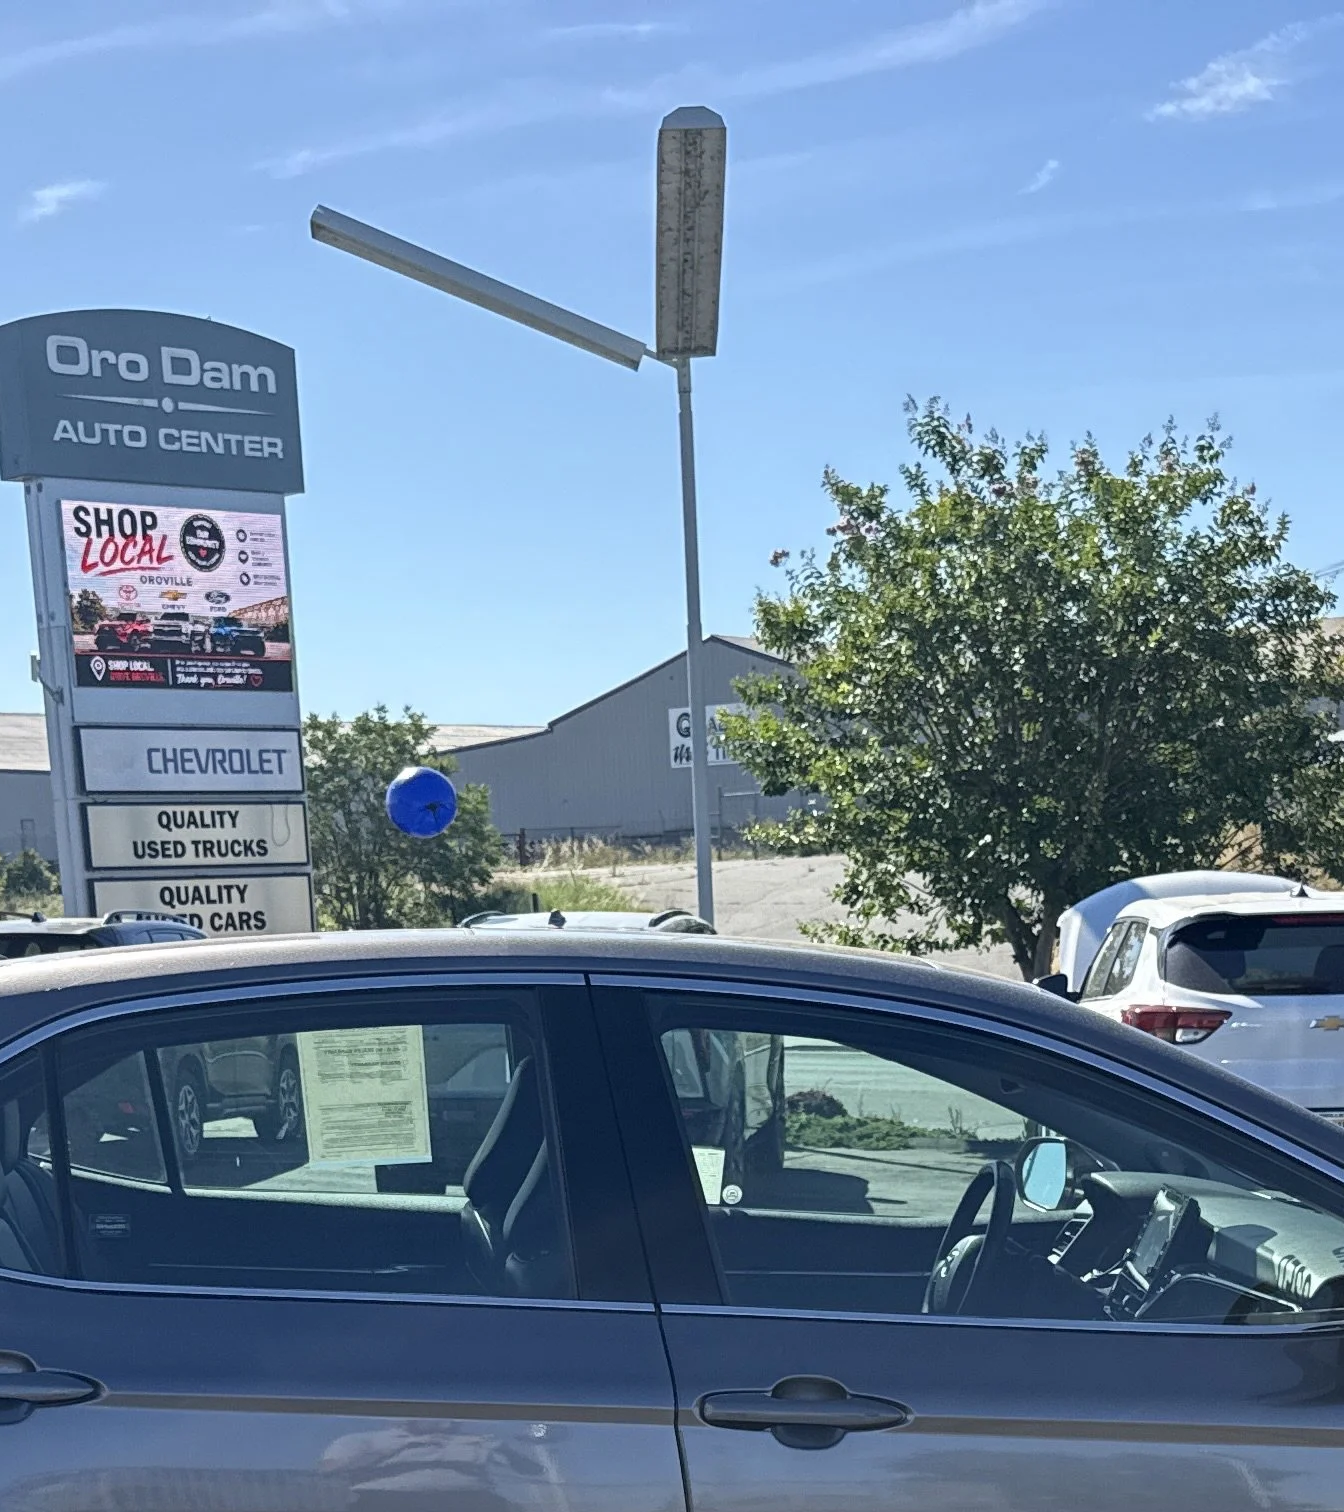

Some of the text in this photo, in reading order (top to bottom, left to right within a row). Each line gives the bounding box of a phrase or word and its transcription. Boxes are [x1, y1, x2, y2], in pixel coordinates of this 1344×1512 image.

[46, 335, 277, 394] Oro Dam
[53, 420, 284, 459] AUTO CENTER
[73, 505, 158, 539] SHOP
[81, 535, 174, 573] LOCAL
[139, 575, 193, 587] OROVILLE
[147, 747, 287, 775] CHEVROLET
[157, 810, 239, 832] QUALITY
[132, 839, 269, 859] USED TRUCKS
[159, 884, 248, 909] QUALITY
[209, 911, 267, 932] CARS
